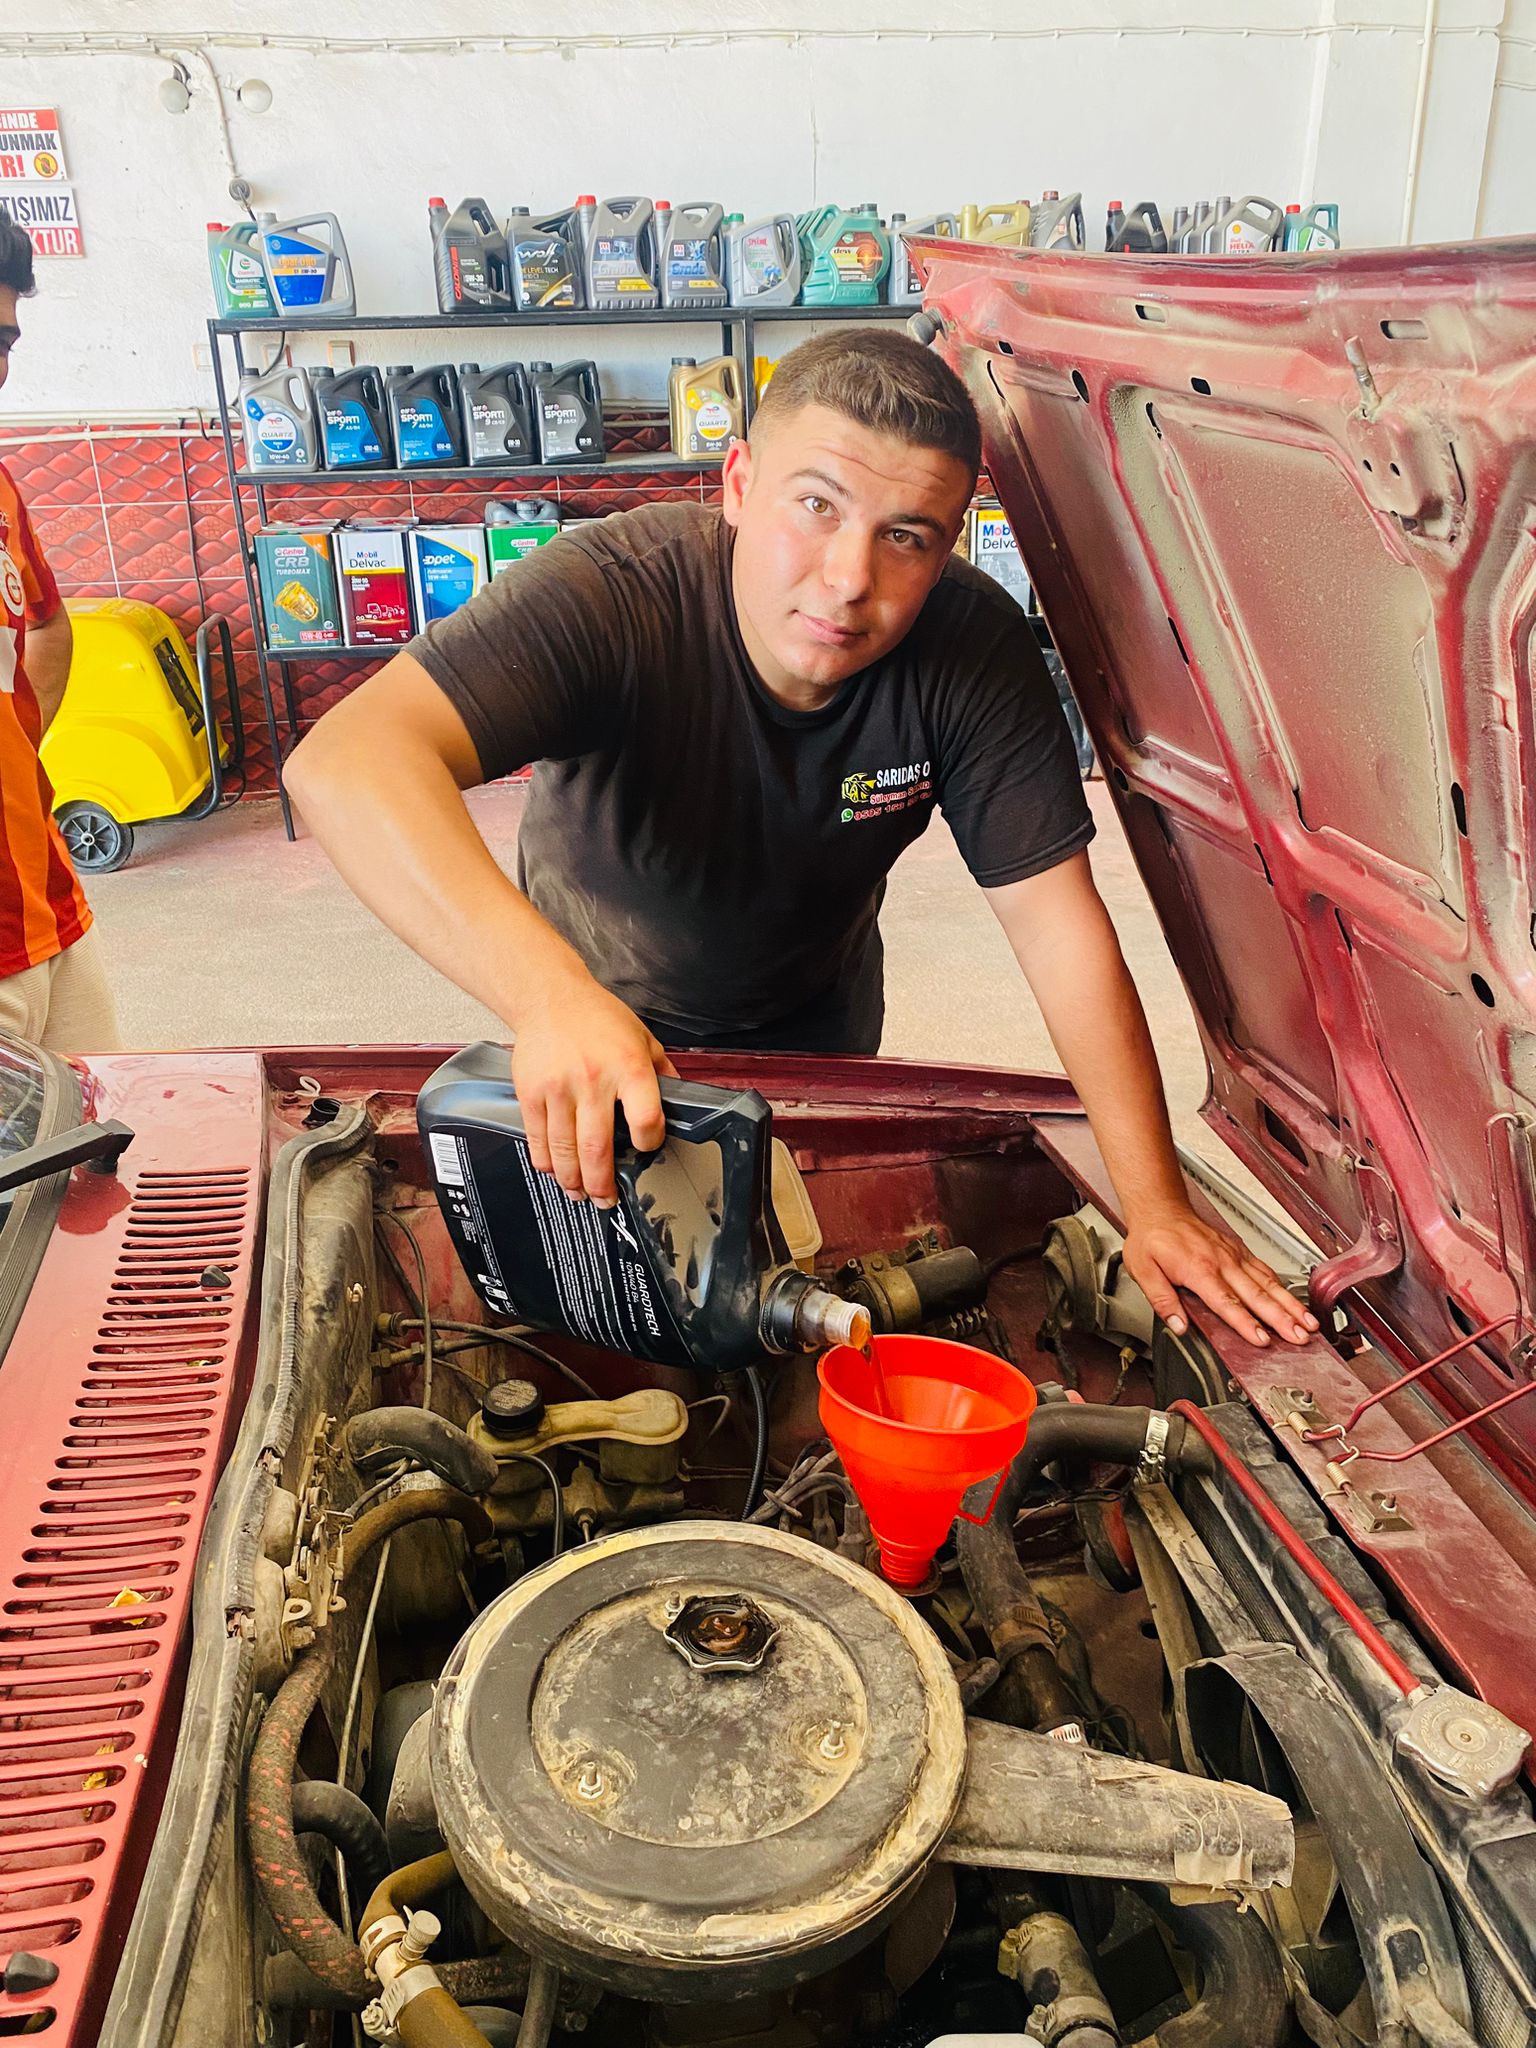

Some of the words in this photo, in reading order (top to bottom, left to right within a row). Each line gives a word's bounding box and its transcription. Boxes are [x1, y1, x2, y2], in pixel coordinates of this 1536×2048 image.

[0, 155, 25, 177] R!
[26, 229, 79, 255] KTUR
[518, 242, 558, 266] wolf
[400, 413, 433, 423] SPORTI
[472, 410, 505, 420] SPORTI
[545, 409, 576, 419] SPORTI
[327, 415, 360, 425] SPORTI
[261, 431, 293, 439] QUARTZ
[983, 524, 1011, 536] Mob
[982, 538, 1017, 550] Delva
[356, 551, 378, 559] Mobil
[274, 557, 310, 568] CRB
[349, 559, 387, 569] Delvac
[275, 568, 311, 576] TURBOMAX
[876, 763, 921, 788] SARIDAŞ
[634, 1263, 662, 1337] GUARDTECH
